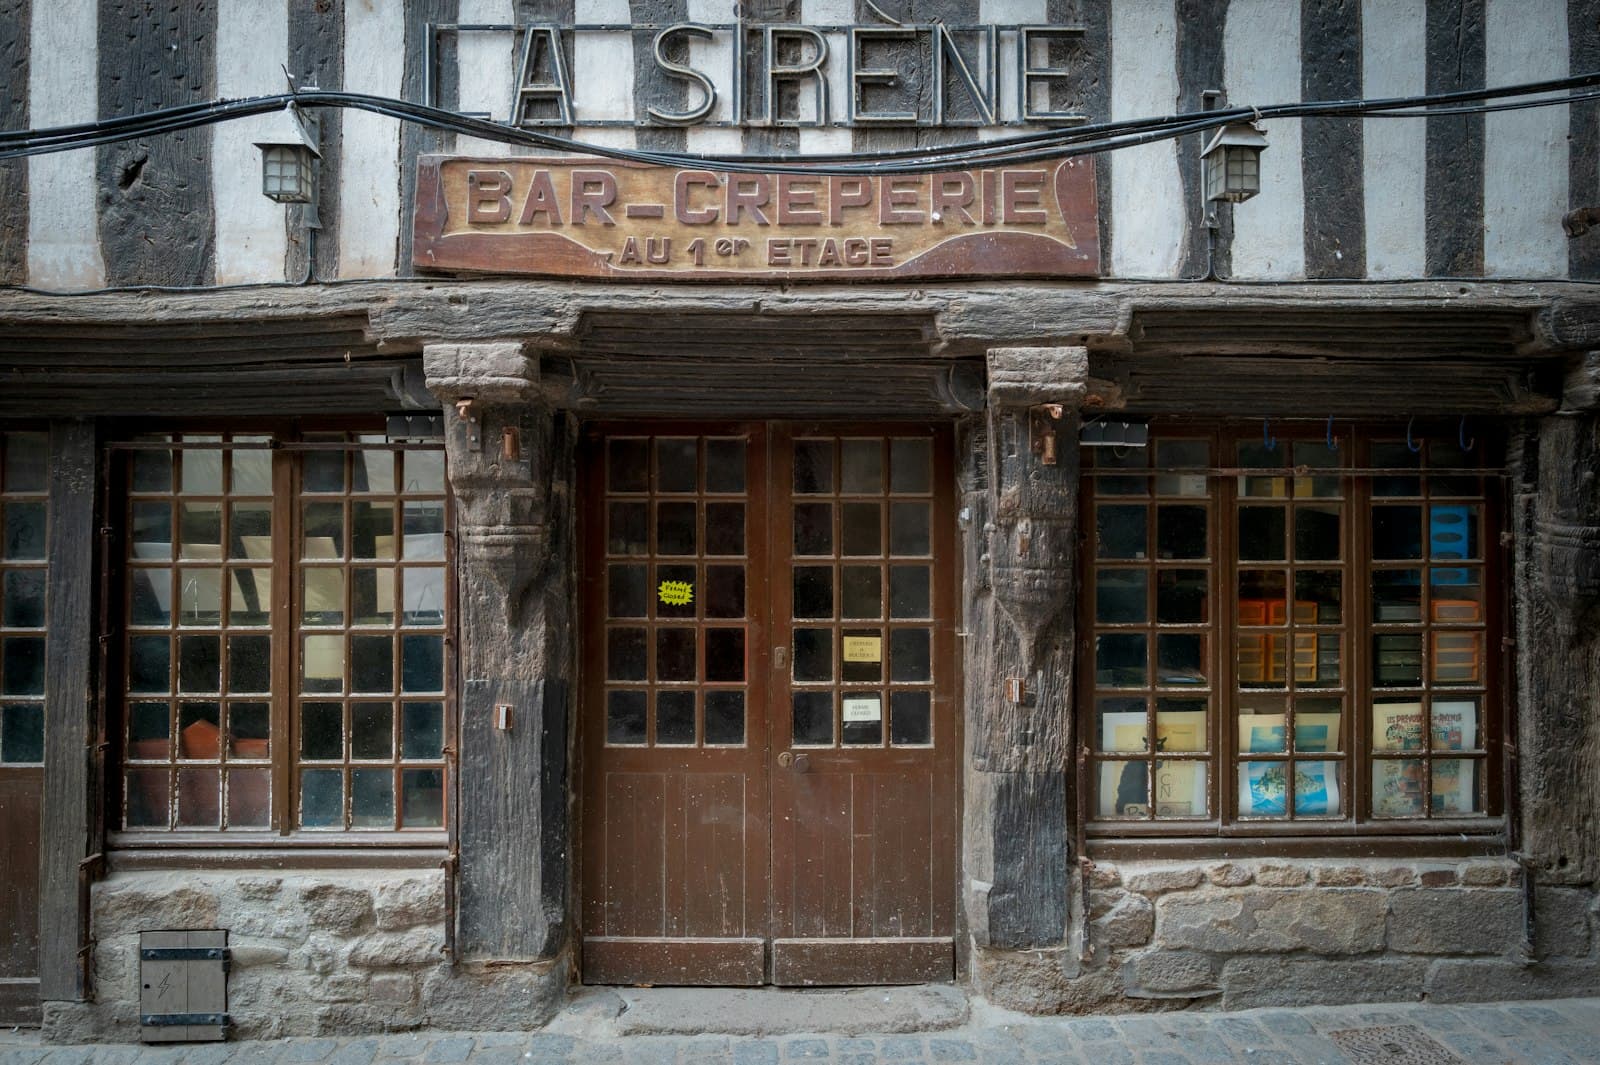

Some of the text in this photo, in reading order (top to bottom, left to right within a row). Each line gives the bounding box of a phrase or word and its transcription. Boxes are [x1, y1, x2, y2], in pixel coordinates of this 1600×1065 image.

[422, 22, 576, 126] LA
[467, 168, 1048, 226] BAR-CREPERIE
[620, 236, 894, 266] AU 1er ETAGE
